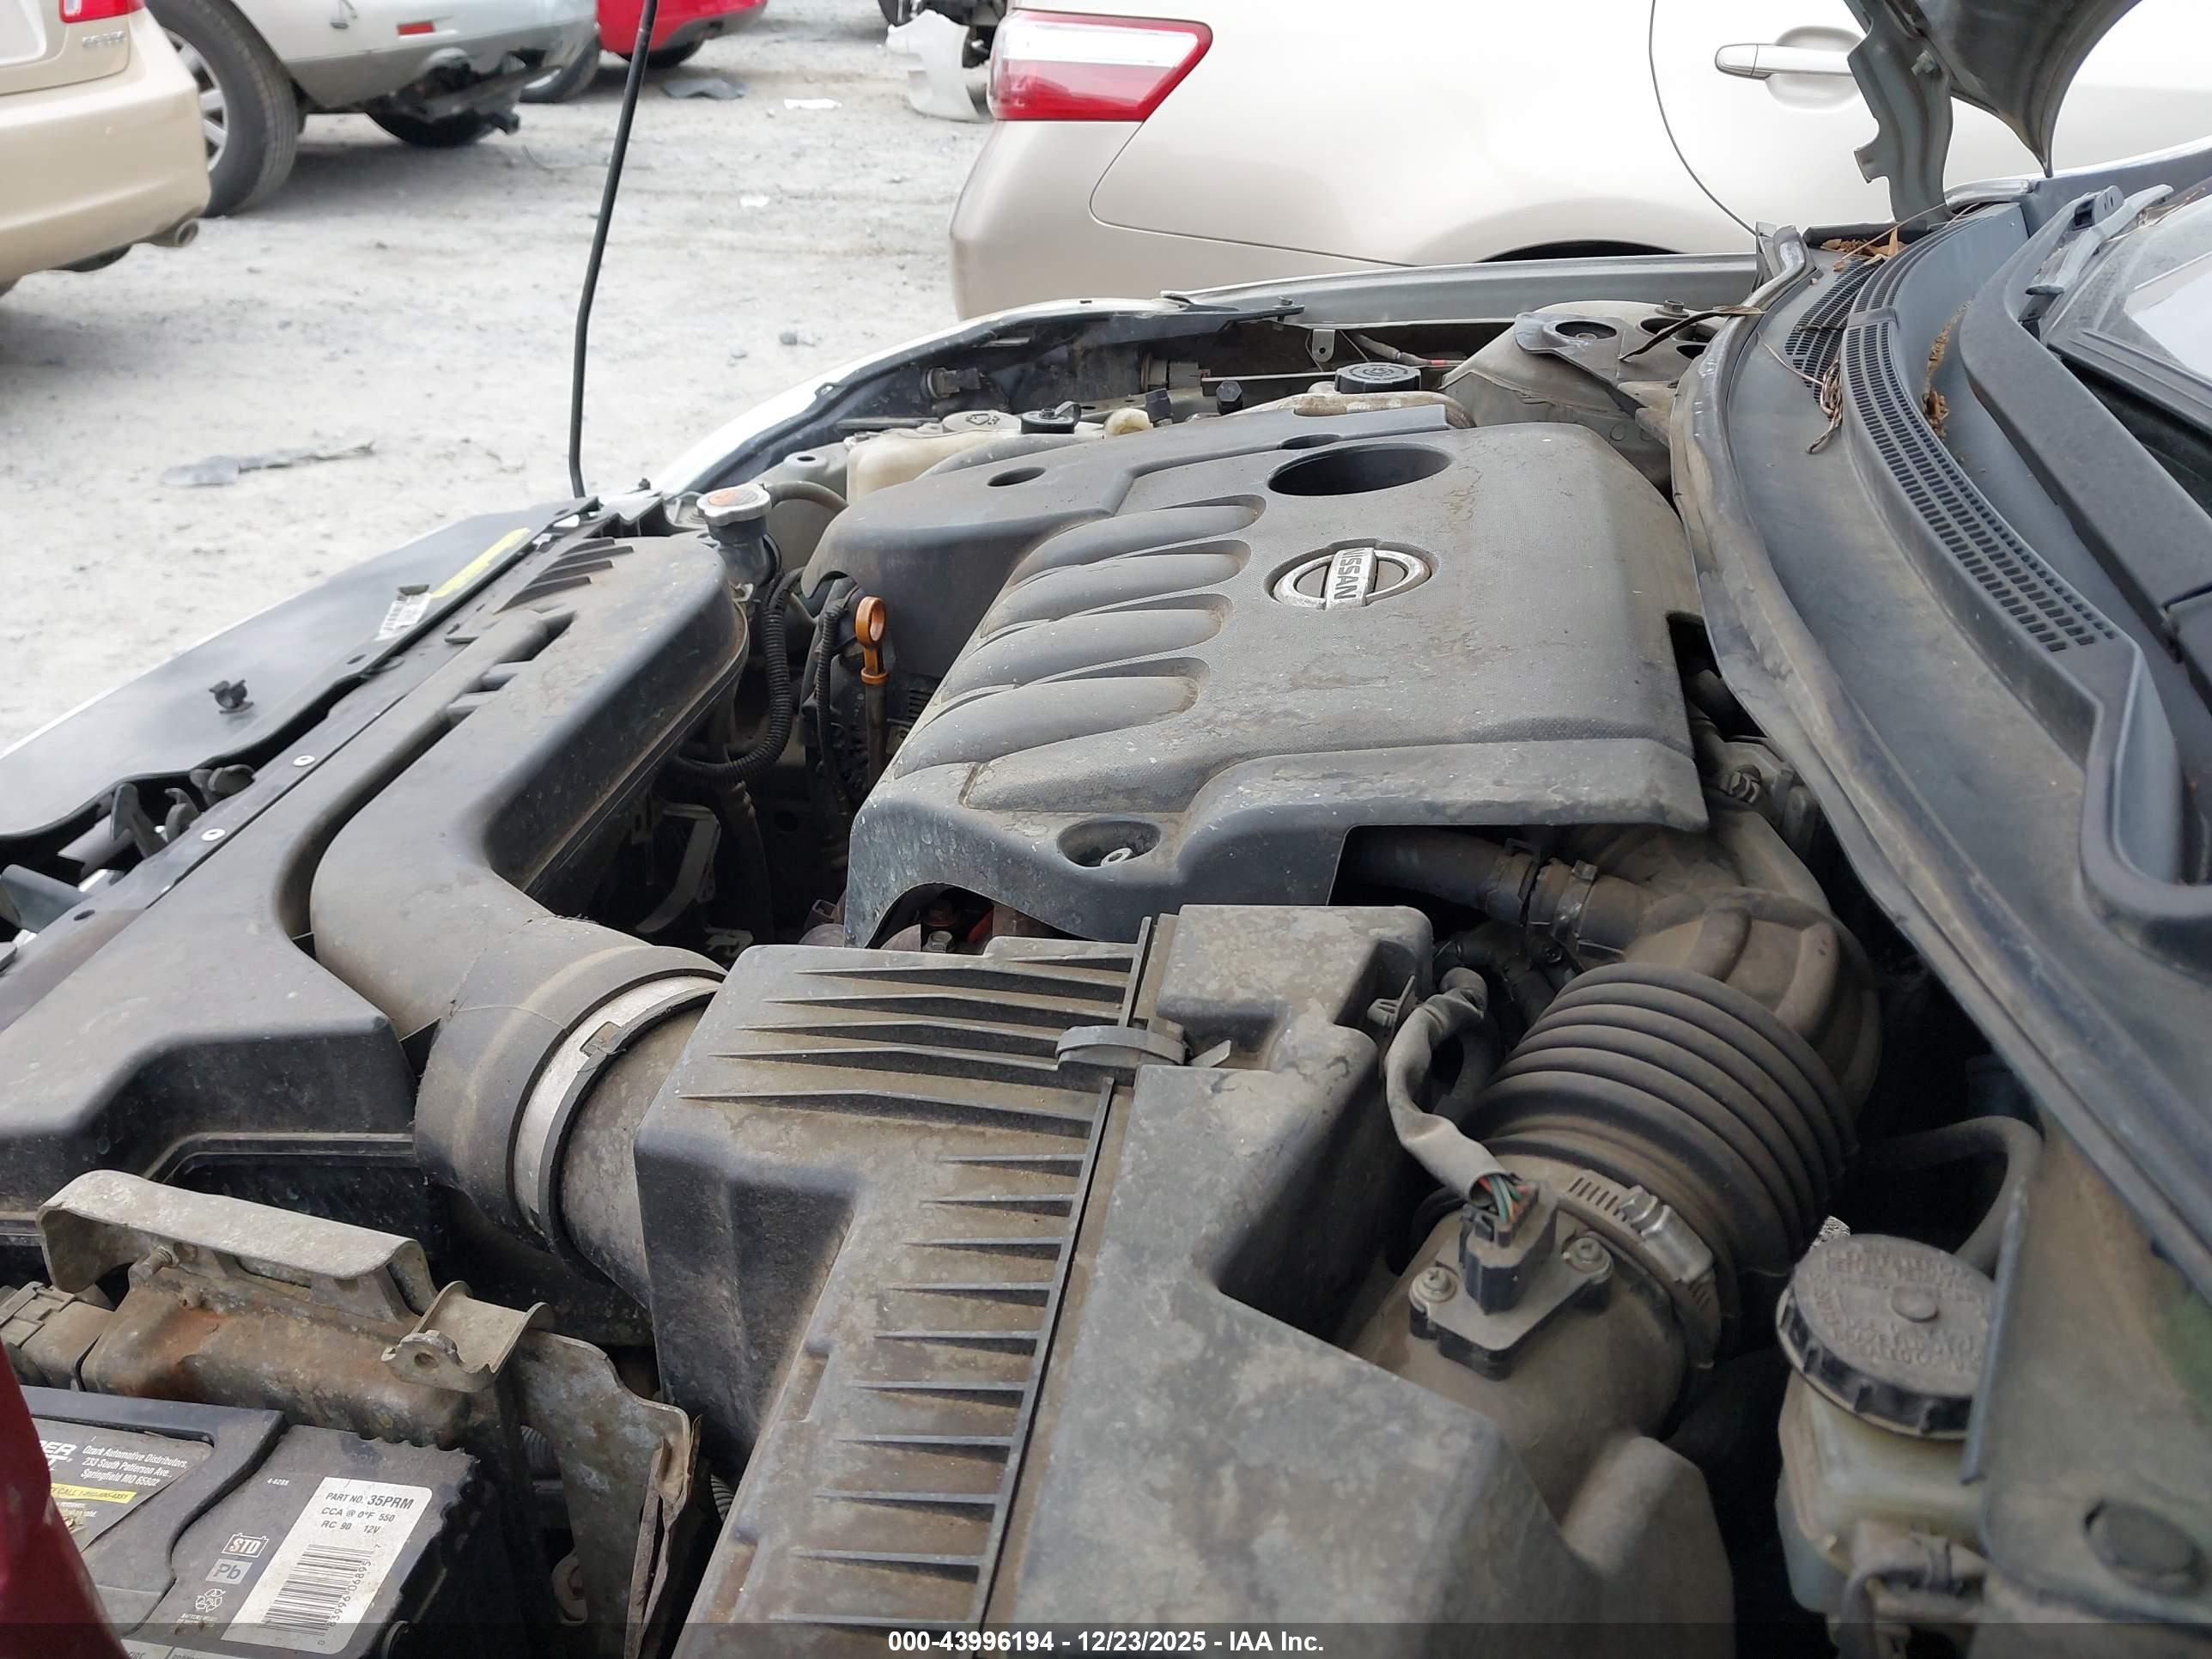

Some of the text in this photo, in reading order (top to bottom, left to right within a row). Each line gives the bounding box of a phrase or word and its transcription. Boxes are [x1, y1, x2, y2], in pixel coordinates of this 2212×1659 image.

[1334, 548, 1365, 599] NISSAN
[82, 1445, 104, 1455] Ozark
[104, 1448, 145, 1461] Automotive
[82, 1457, 97, 1467] 233
[97, 1459, 118, 1470] South
[118, 1462, 154, 1475] Patterson
[81, 1468, 161, 1487] Springfield MO 65802
[325, 1492, 415, 1510] PART NO. 35PRM
[321, 1507, 343, 1516] CCA
[379, 1513, 395, 1522] 550
[321, 1520, 381, 1534] RC 90 12V
[228, 1538, 261, 1554] STD
[213, 1563, 241, 1580] Pb
